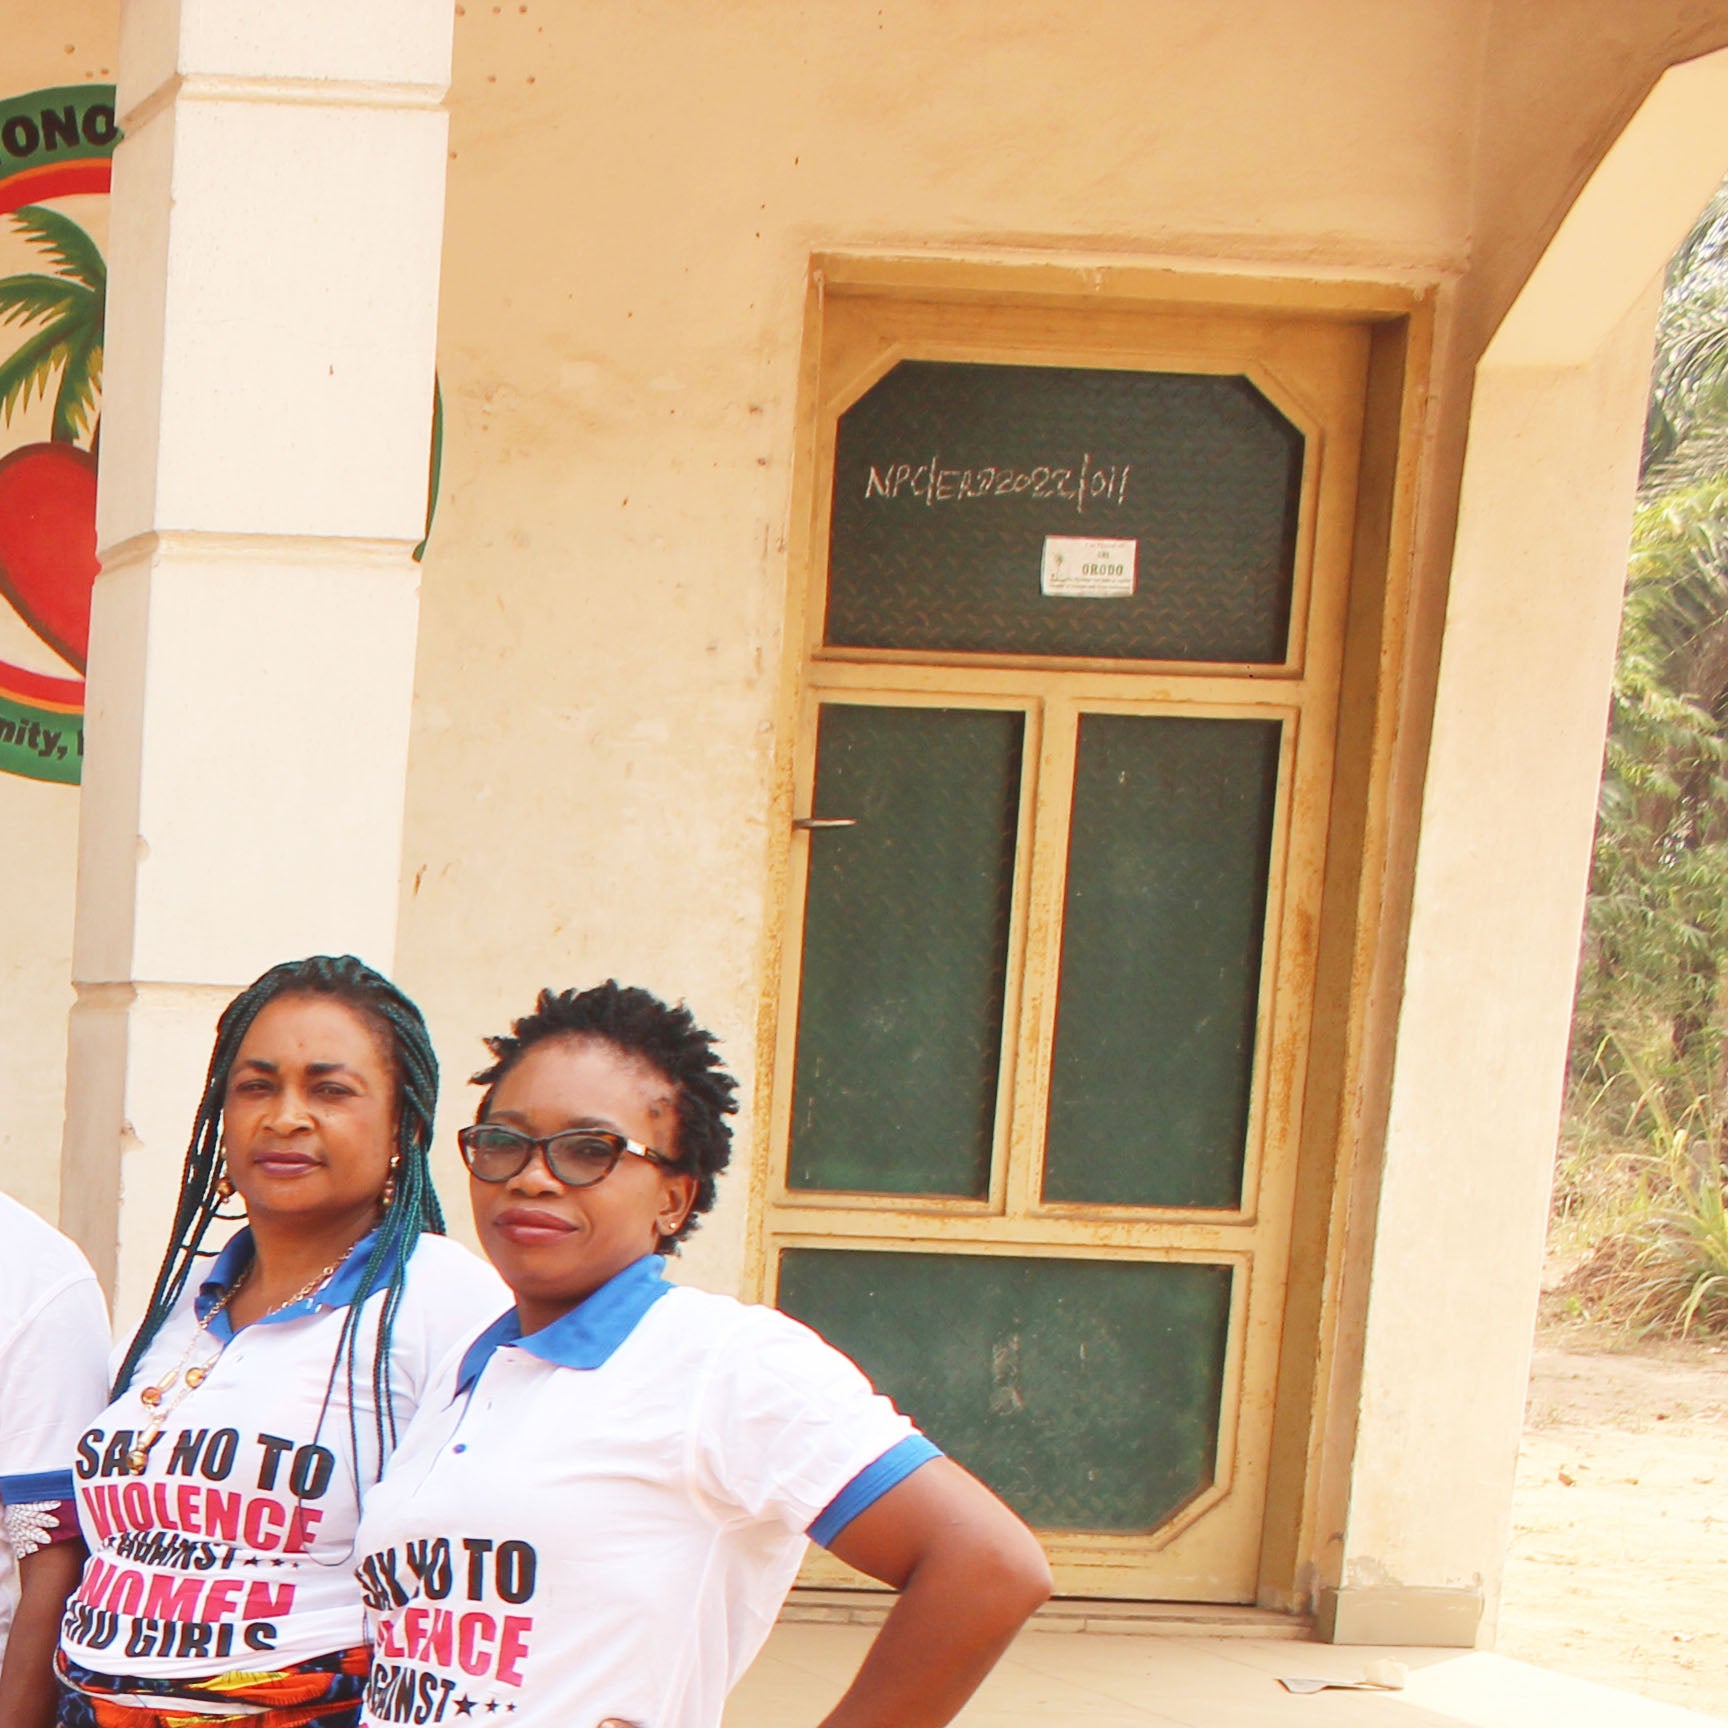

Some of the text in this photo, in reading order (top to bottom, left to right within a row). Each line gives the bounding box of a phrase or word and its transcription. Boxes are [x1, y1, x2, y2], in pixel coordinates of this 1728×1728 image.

[1082, 563, 1123, 576] ORODO
[166, 1427, 240, 1482] NO
[256, 1432, 335, 1501] TO
[81, 1481, 324, 1554] VIOLENCE
[462, 1537, 537, 1606] TO
[377, 1606, 533, 1688] LENCE
[365, 1663, 457, 1725] GAINST
